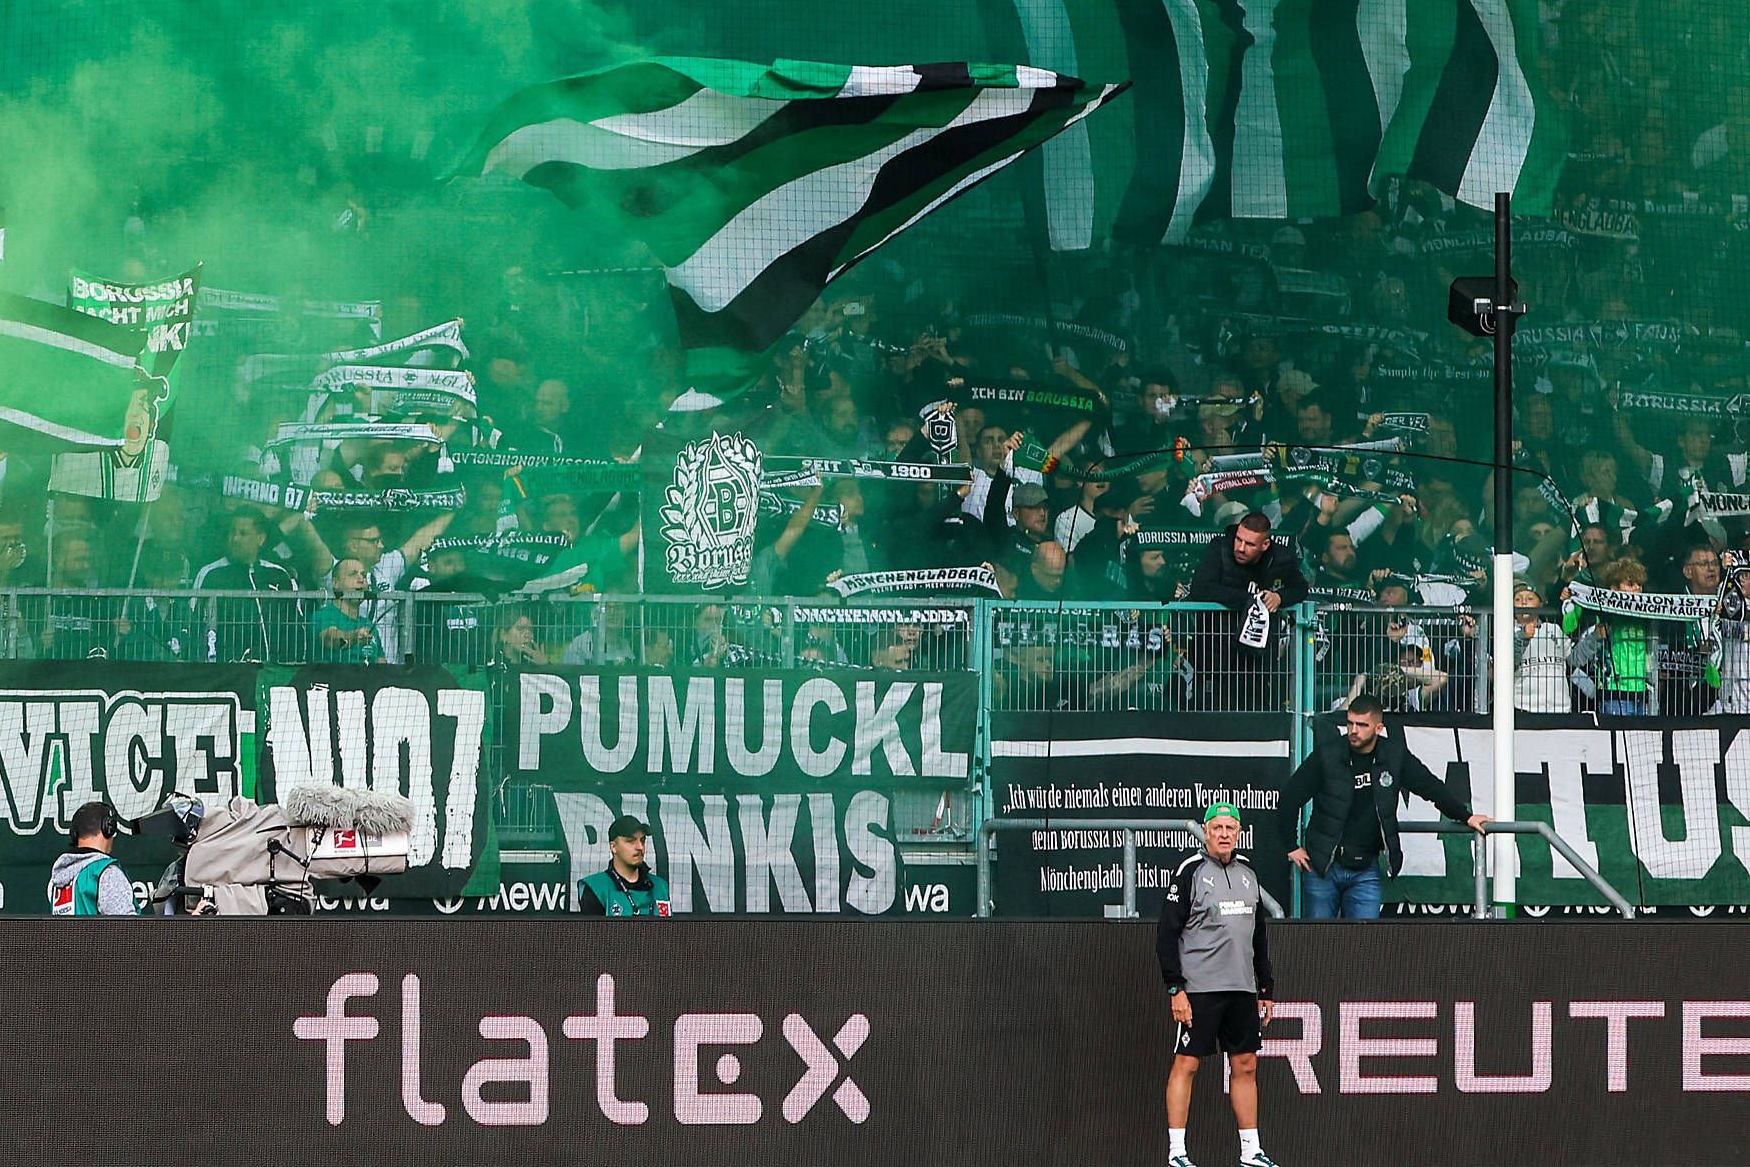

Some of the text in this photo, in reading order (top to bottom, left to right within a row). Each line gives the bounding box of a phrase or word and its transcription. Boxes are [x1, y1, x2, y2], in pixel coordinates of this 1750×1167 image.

[72, 276, 195, 303] BORUSSIA
[145, 298, 190, 323] MICH
[971, 385, 1094, 412] ICH BIN BORUSSIA
[890, 463, 932, 480] 1900
[283, 483, 304, 513] 07
[842, 565, 996, 592] MÖNCHENGLADBACH
[1607, 597, 1632, 611] MAN
[1634, 600, 1669, 614] NICHT
[1669, 603, 1717, 617] KAUFEN
[1679, 595, 1707, 608] IST
[518, 671, 969, 779] PUMUCKL
[1027, 784, 1063, 810] würde
[1064, 783, 1110, 810] niemals
[1111, 783, 1143, 808] einen
[1145, 783, 1192, 809] anderen
[294, 972, 871, 1128] flatex
